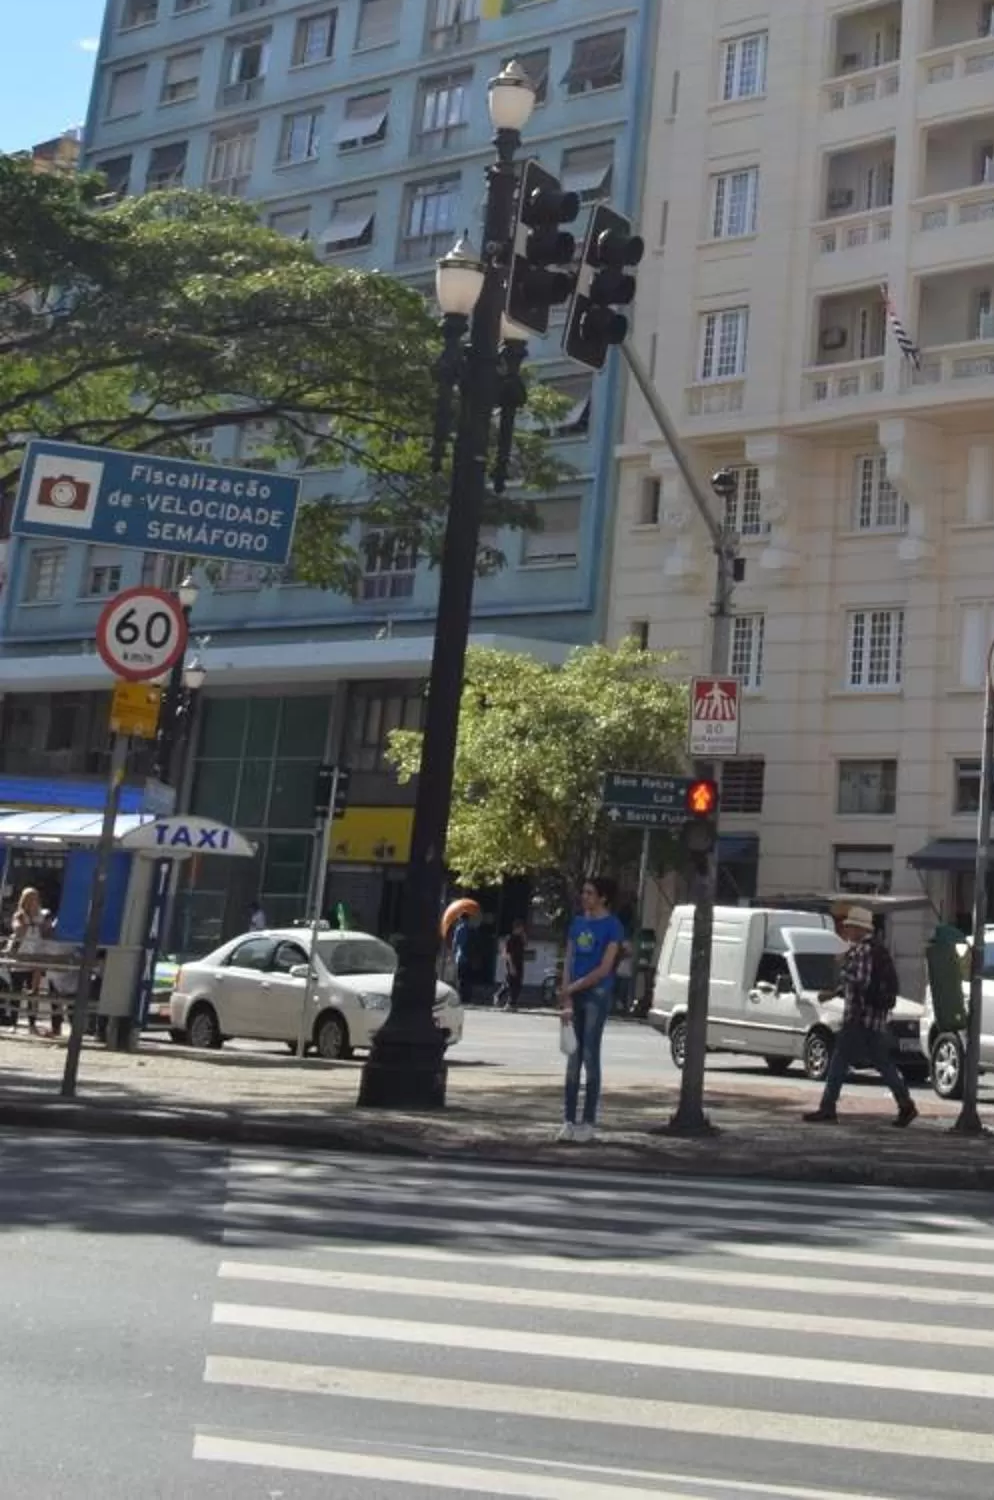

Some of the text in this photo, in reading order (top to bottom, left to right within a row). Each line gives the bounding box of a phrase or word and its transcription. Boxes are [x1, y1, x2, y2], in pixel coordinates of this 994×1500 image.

[130, 464, 272, 499] Fiscalização
[107, 490, 286, 528] de VELOCIDADE
[114, 517, 270, 552] e SEMÁFORO
[115, 607, 172, 648] 60
[155, 824, 231, 850] TAXI
